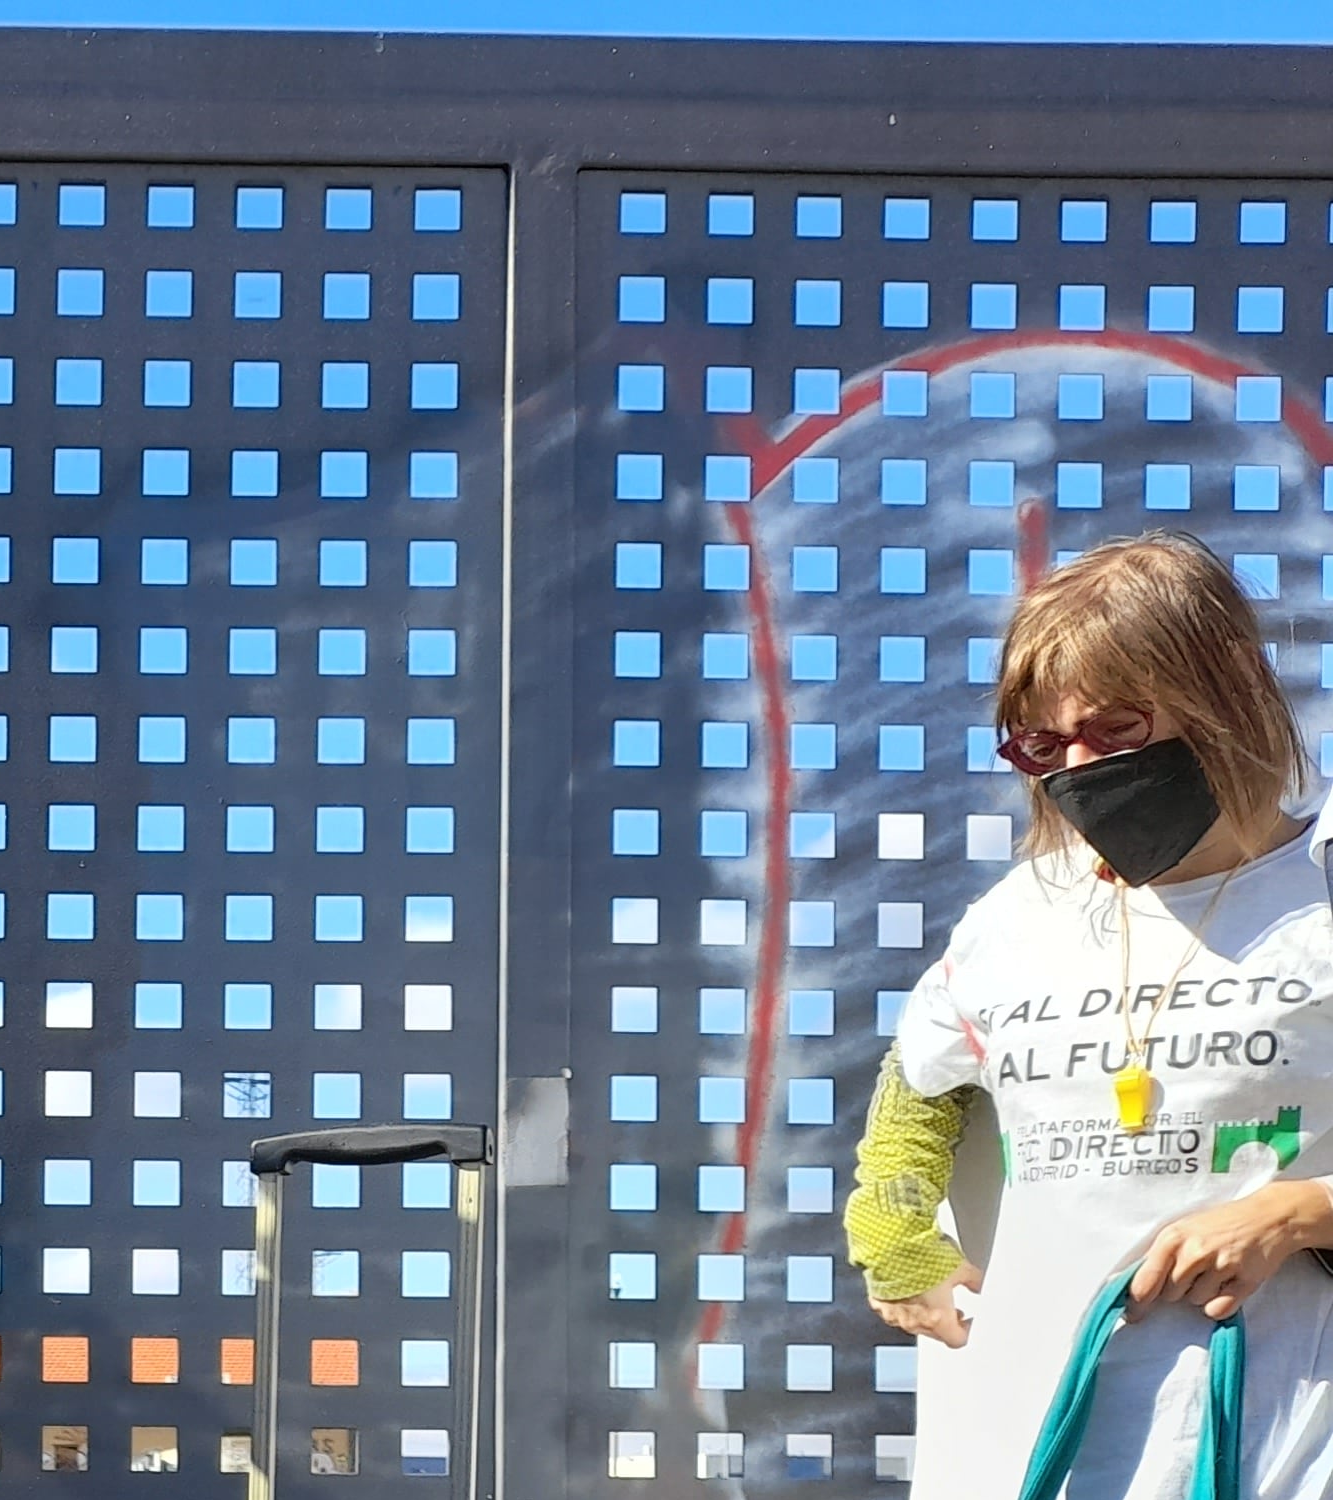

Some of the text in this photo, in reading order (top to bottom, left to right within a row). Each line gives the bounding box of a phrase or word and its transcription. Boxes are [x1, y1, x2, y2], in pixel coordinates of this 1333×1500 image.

[998, 994, 1062, 1029] AL
[998, 1029, 1291, 1089] AL FUTURO.
[1049, 1128, 1201, 1162] DIRECTO
